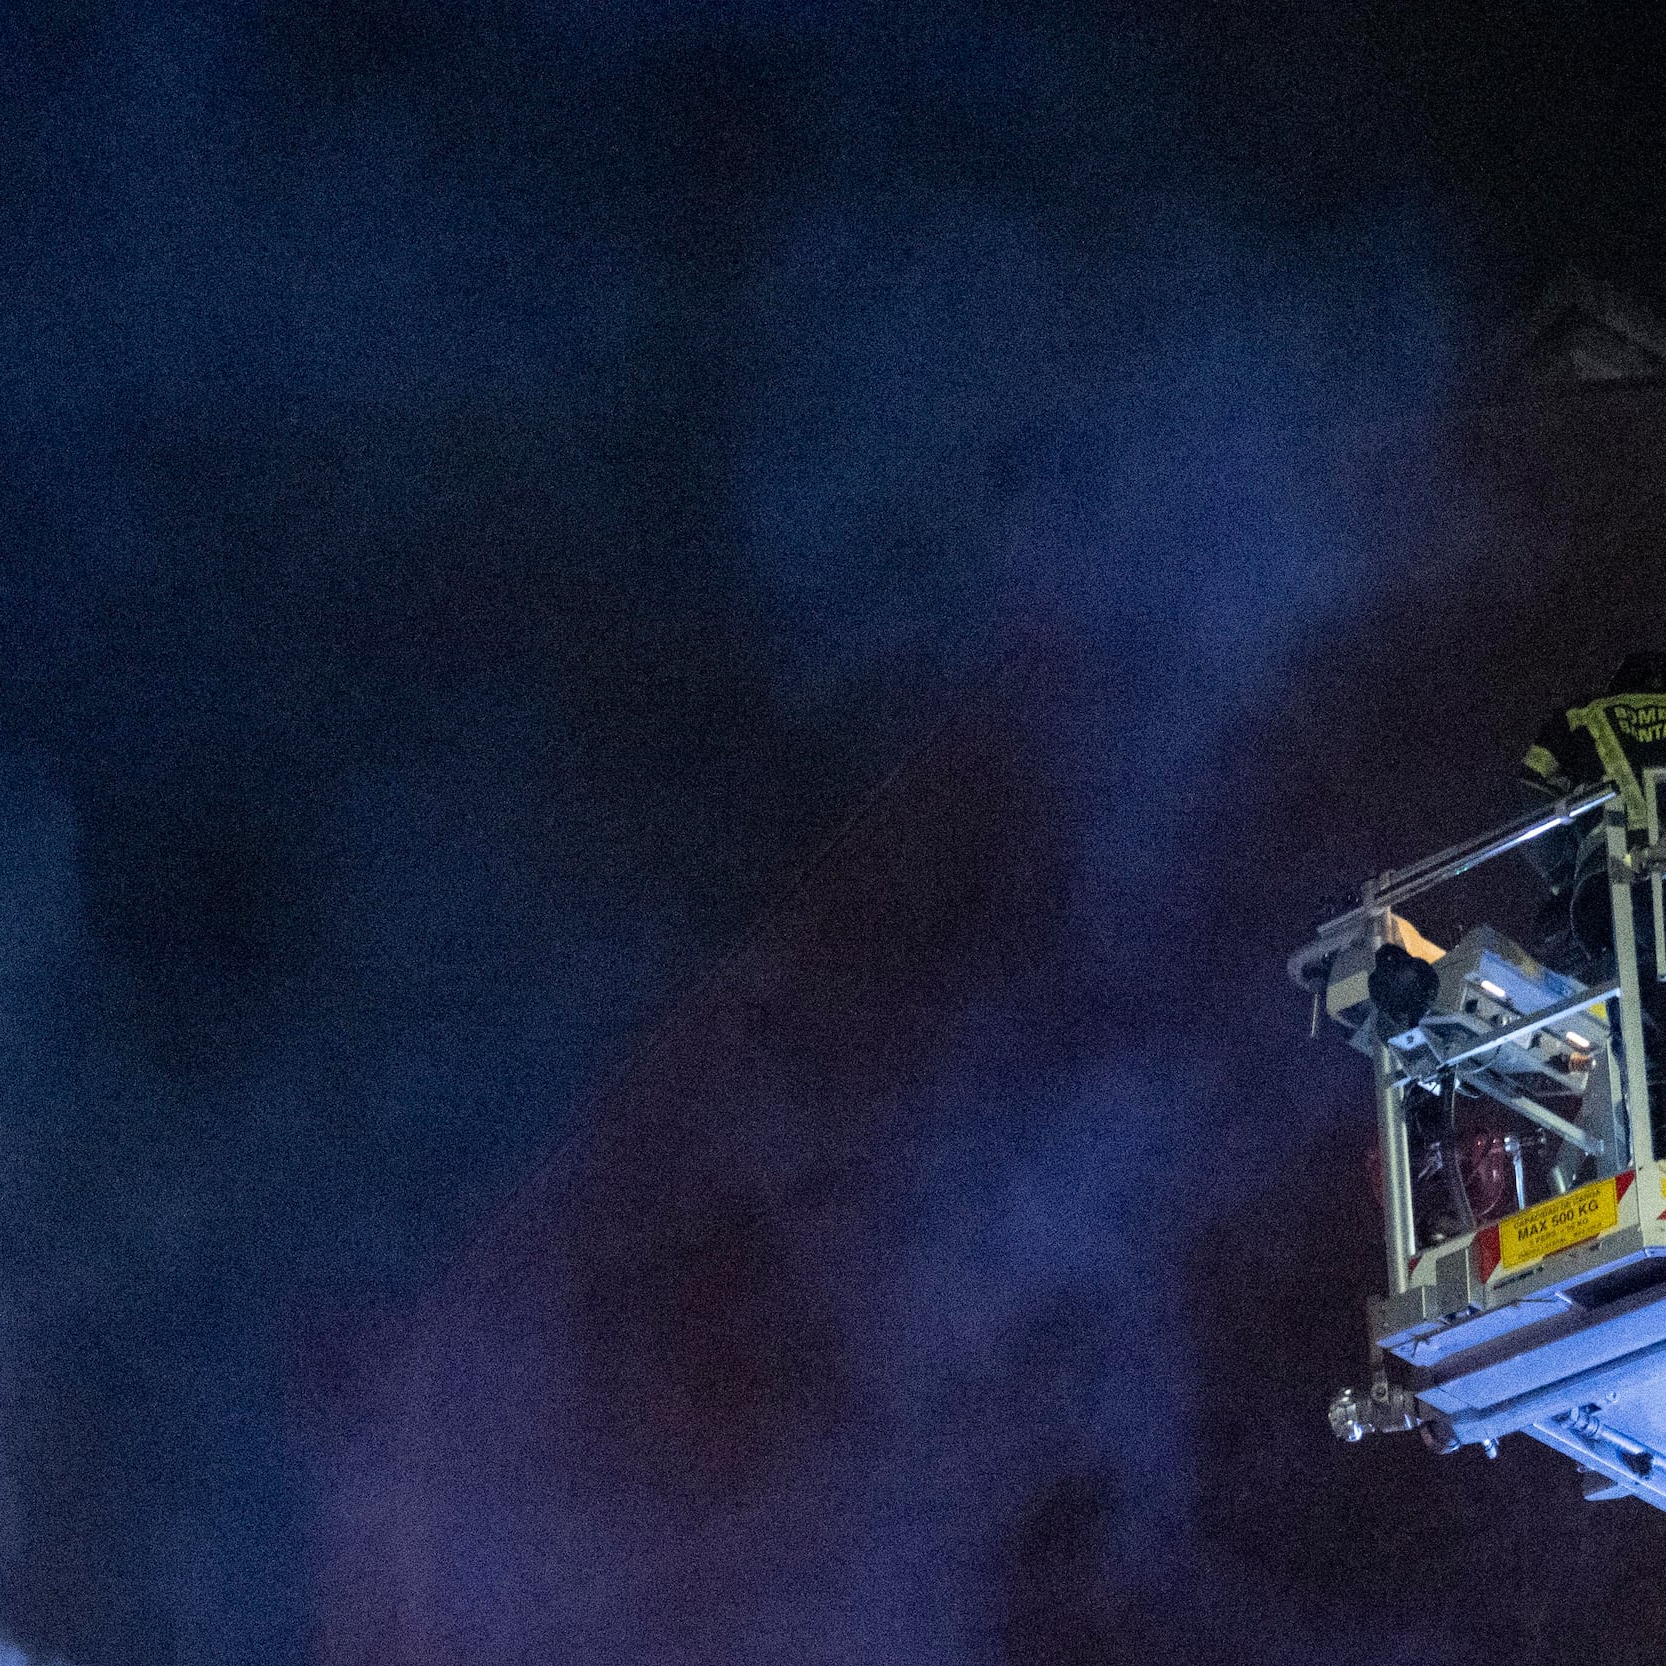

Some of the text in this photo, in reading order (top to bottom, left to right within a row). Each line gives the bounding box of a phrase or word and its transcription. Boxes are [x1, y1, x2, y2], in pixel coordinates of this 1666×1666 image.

[1518, 1220, 1547, 1241] MAX
[1551, 1209, 1574, 1227] 500
[1578, 1199, 1599, 1217] KG
